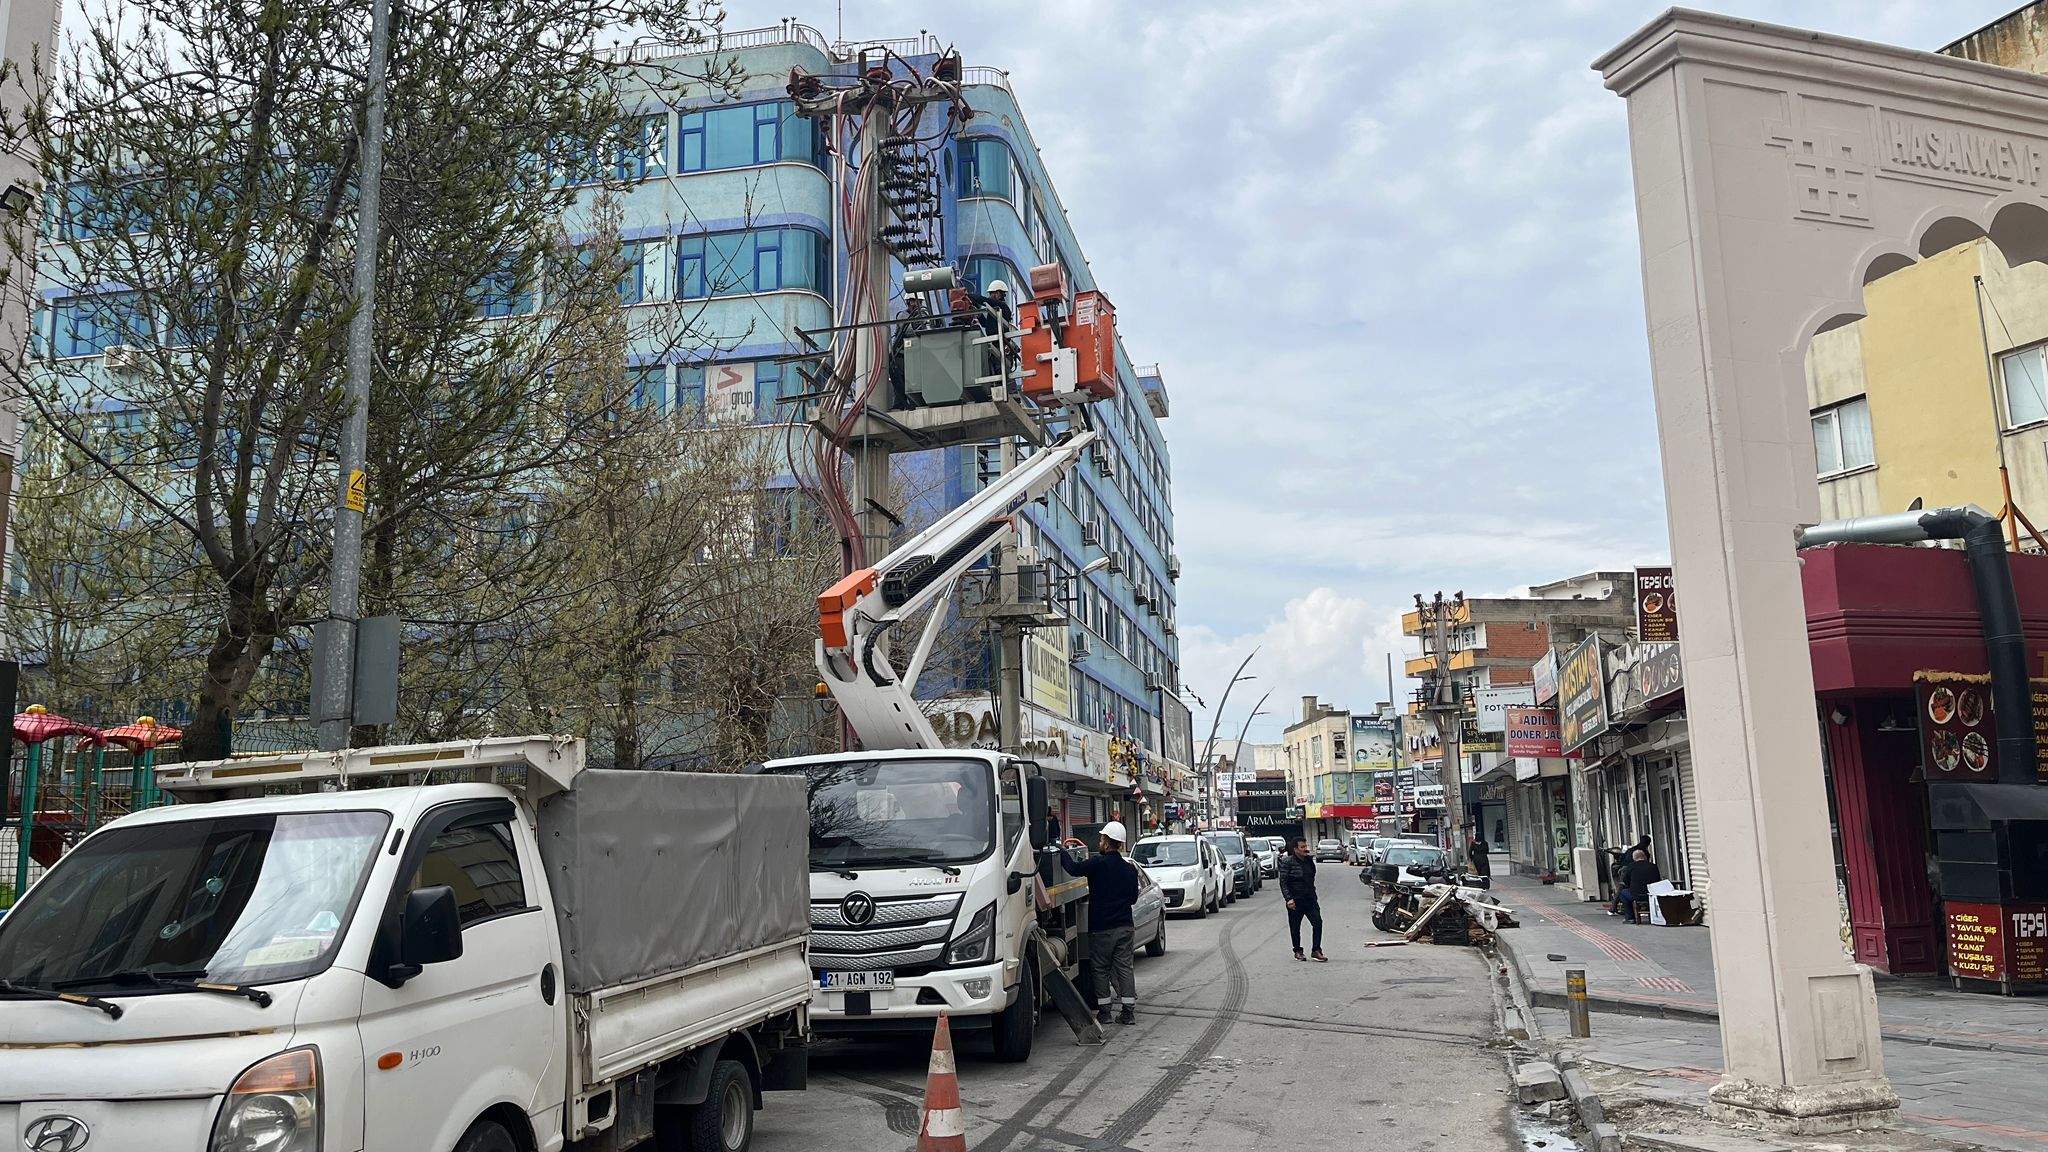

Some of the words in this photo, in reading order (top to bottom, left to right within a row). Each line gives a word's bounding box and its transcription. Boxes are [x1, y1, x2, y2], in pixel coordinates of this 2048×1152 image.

[1523, 713, 1547, 726] ADİL
[1246, 815, 1273, 825] ARMA
[1956, 924, 1983, 933] TAVUK
[1957, 933, 1986, 942] ADANA
[1957, 943, 1985, 952] KANAT
[1958, 952, 1993, 964] KUŞBAŞI
[1959, 962, 1981, 971] KUZU
[827, 973, 839, 986] 21
[847, 972, 866, 986] AGN
[873, 972, 892, 985] 192
